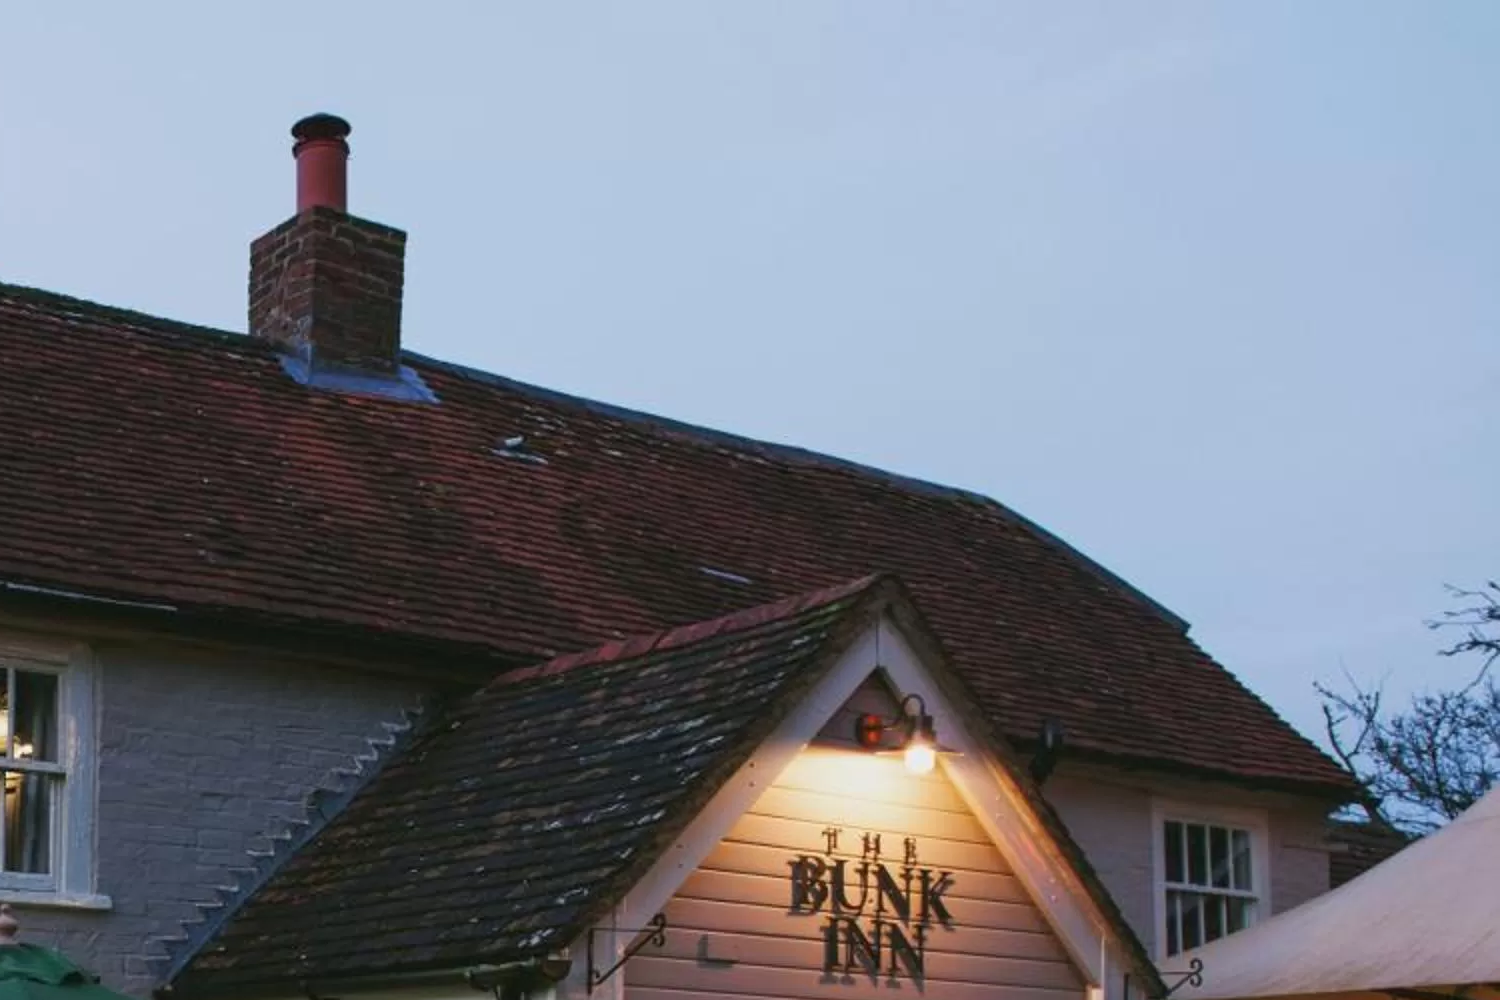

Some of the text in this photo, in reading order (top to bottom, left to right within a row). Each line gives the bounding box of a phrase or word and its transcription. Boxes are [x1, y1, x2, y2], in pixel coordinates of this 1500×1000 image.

[821, 827, 918, 865] THE
[787, 854, 956, 931] BUNK
[818, 916, 926, 993] INN
